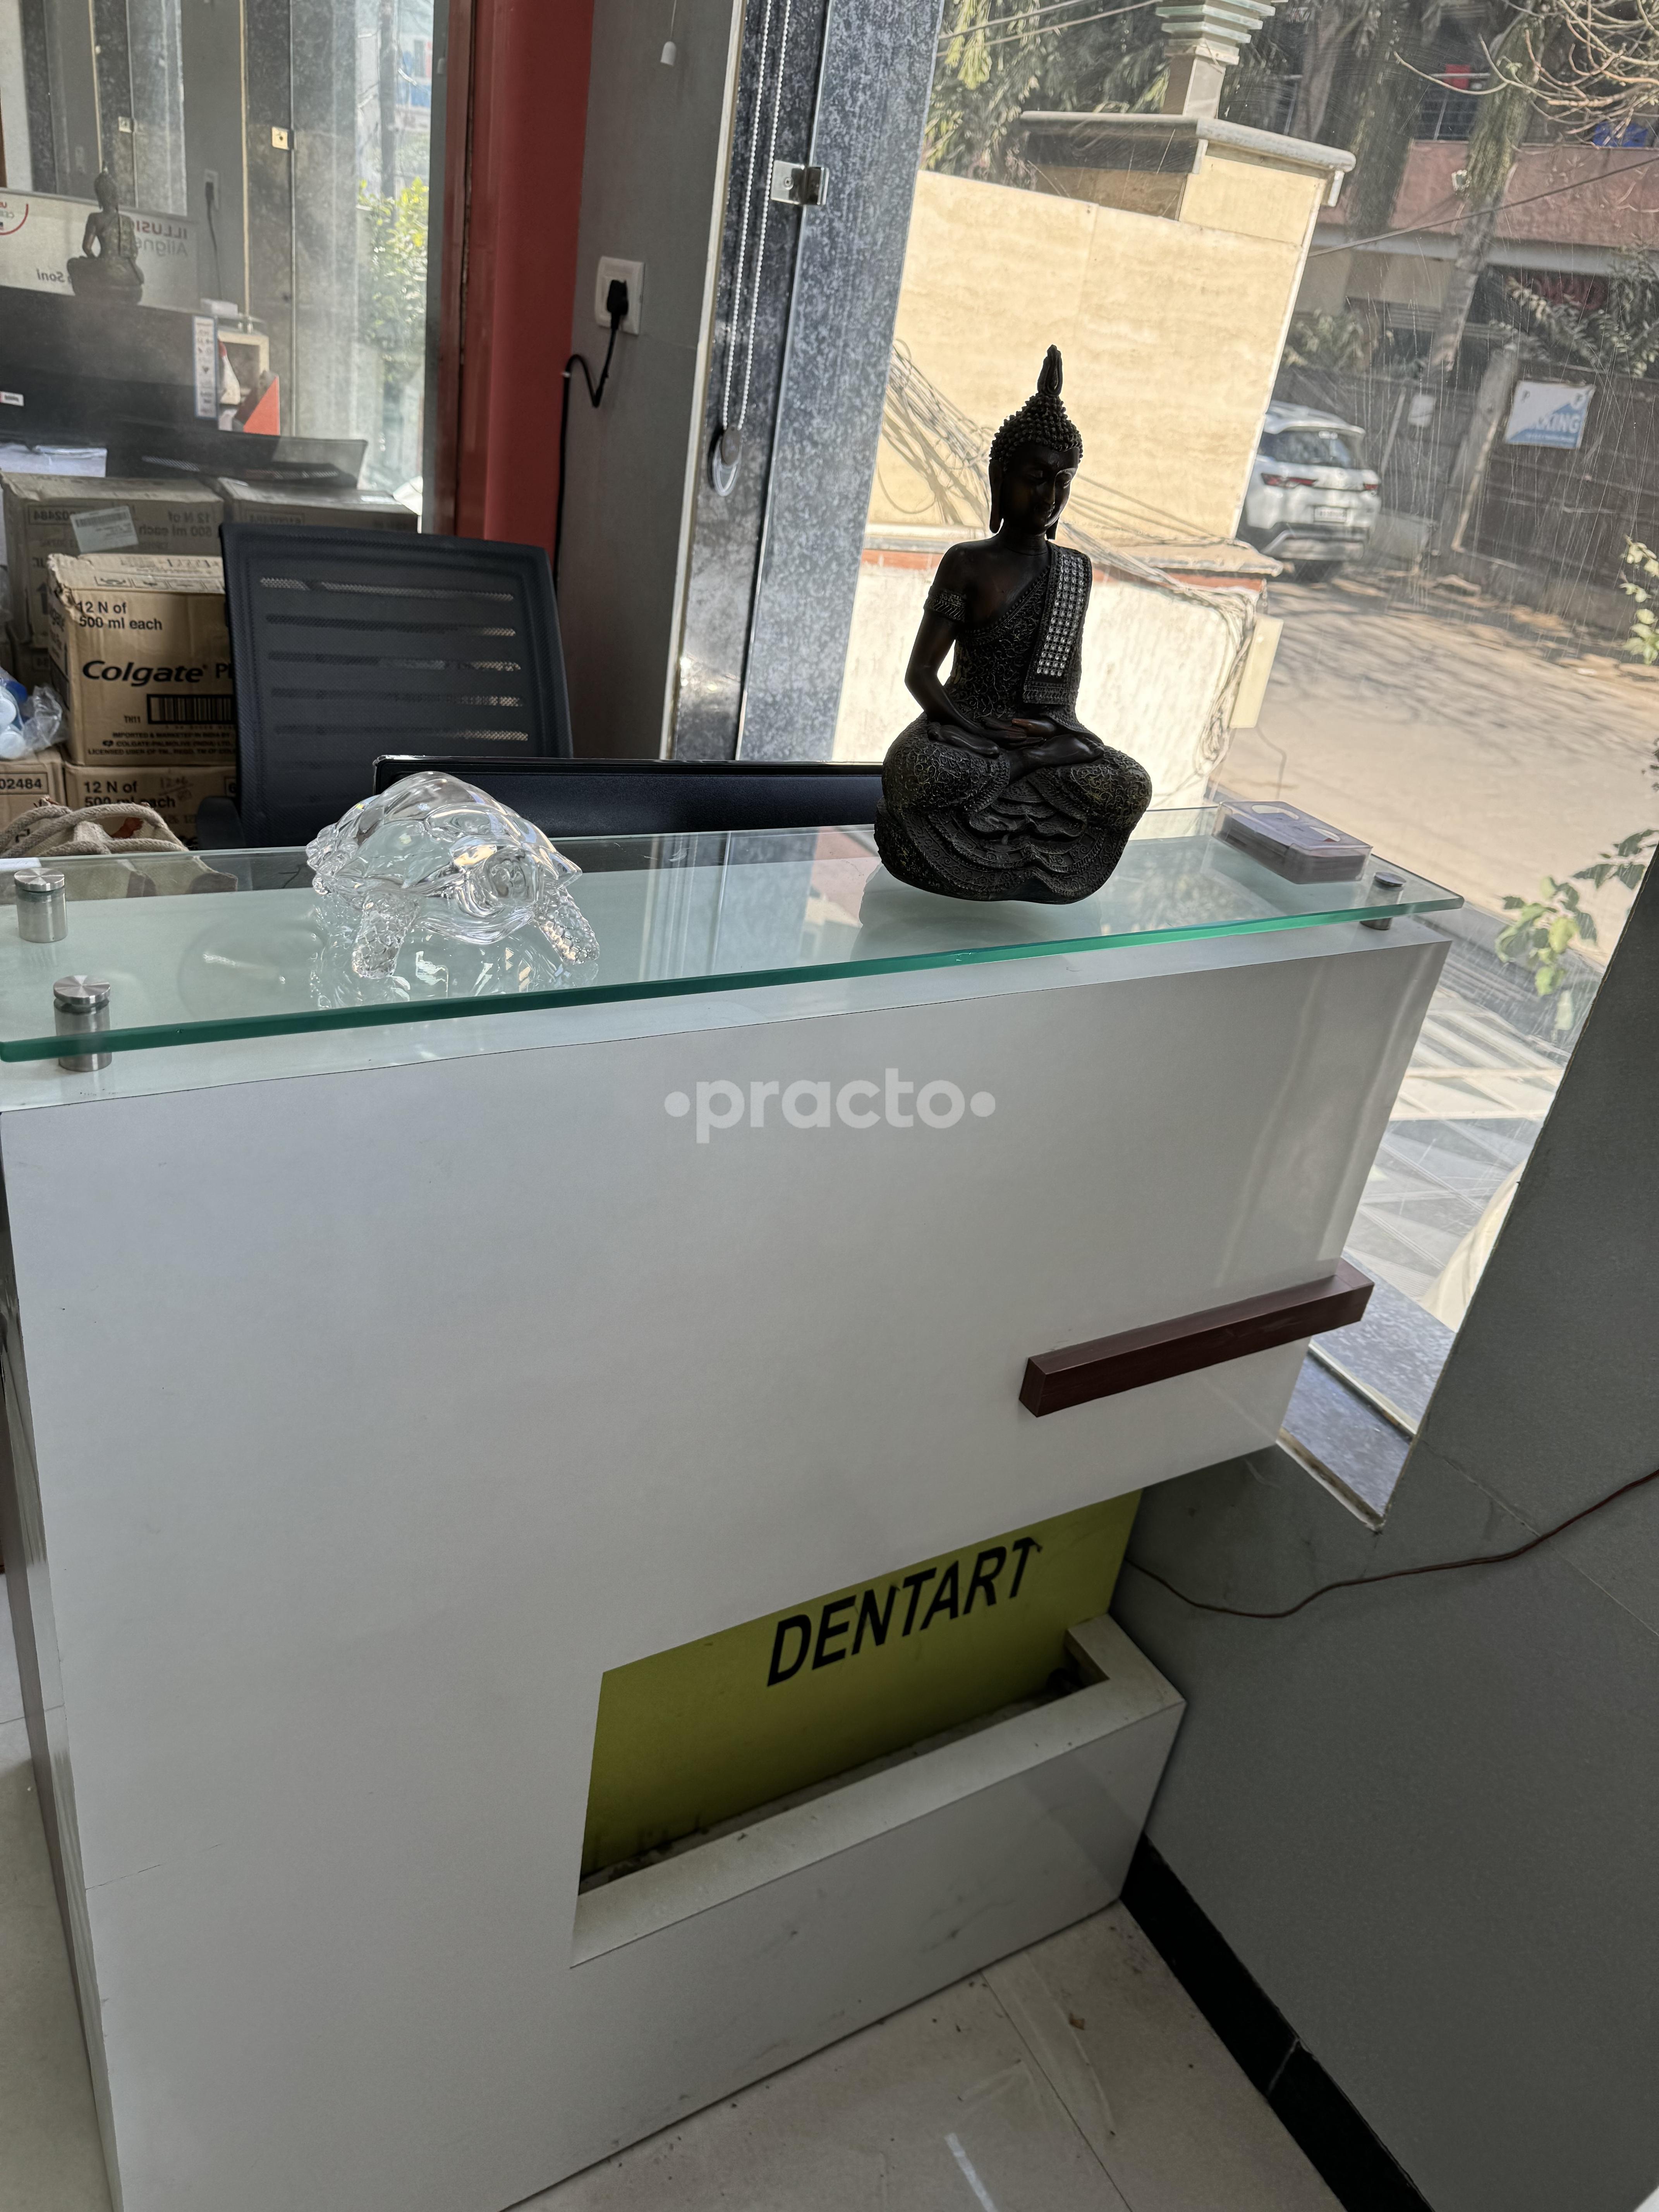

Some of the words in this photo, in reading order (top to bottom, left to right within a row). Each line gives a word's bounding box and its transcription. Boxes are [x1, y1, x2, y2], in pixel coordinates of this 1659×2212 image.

[77, 601, 93, 613] 12
[98, 601, 109, 613] N
[113, 601, 127, 614] of
[79, 617, 104, 628] 500
[108, 617, 124, 629] ml
[130, 618, 162, 630] each
[82, 660, 203, 687] Colgate
[84, 781, 102, 793] 12
[107, 781, 117, 793] N
[123, 781, 137, 793] of
[85, 797, 111, 807] 500
[767, 1536, 1043, 1687] DENTART
